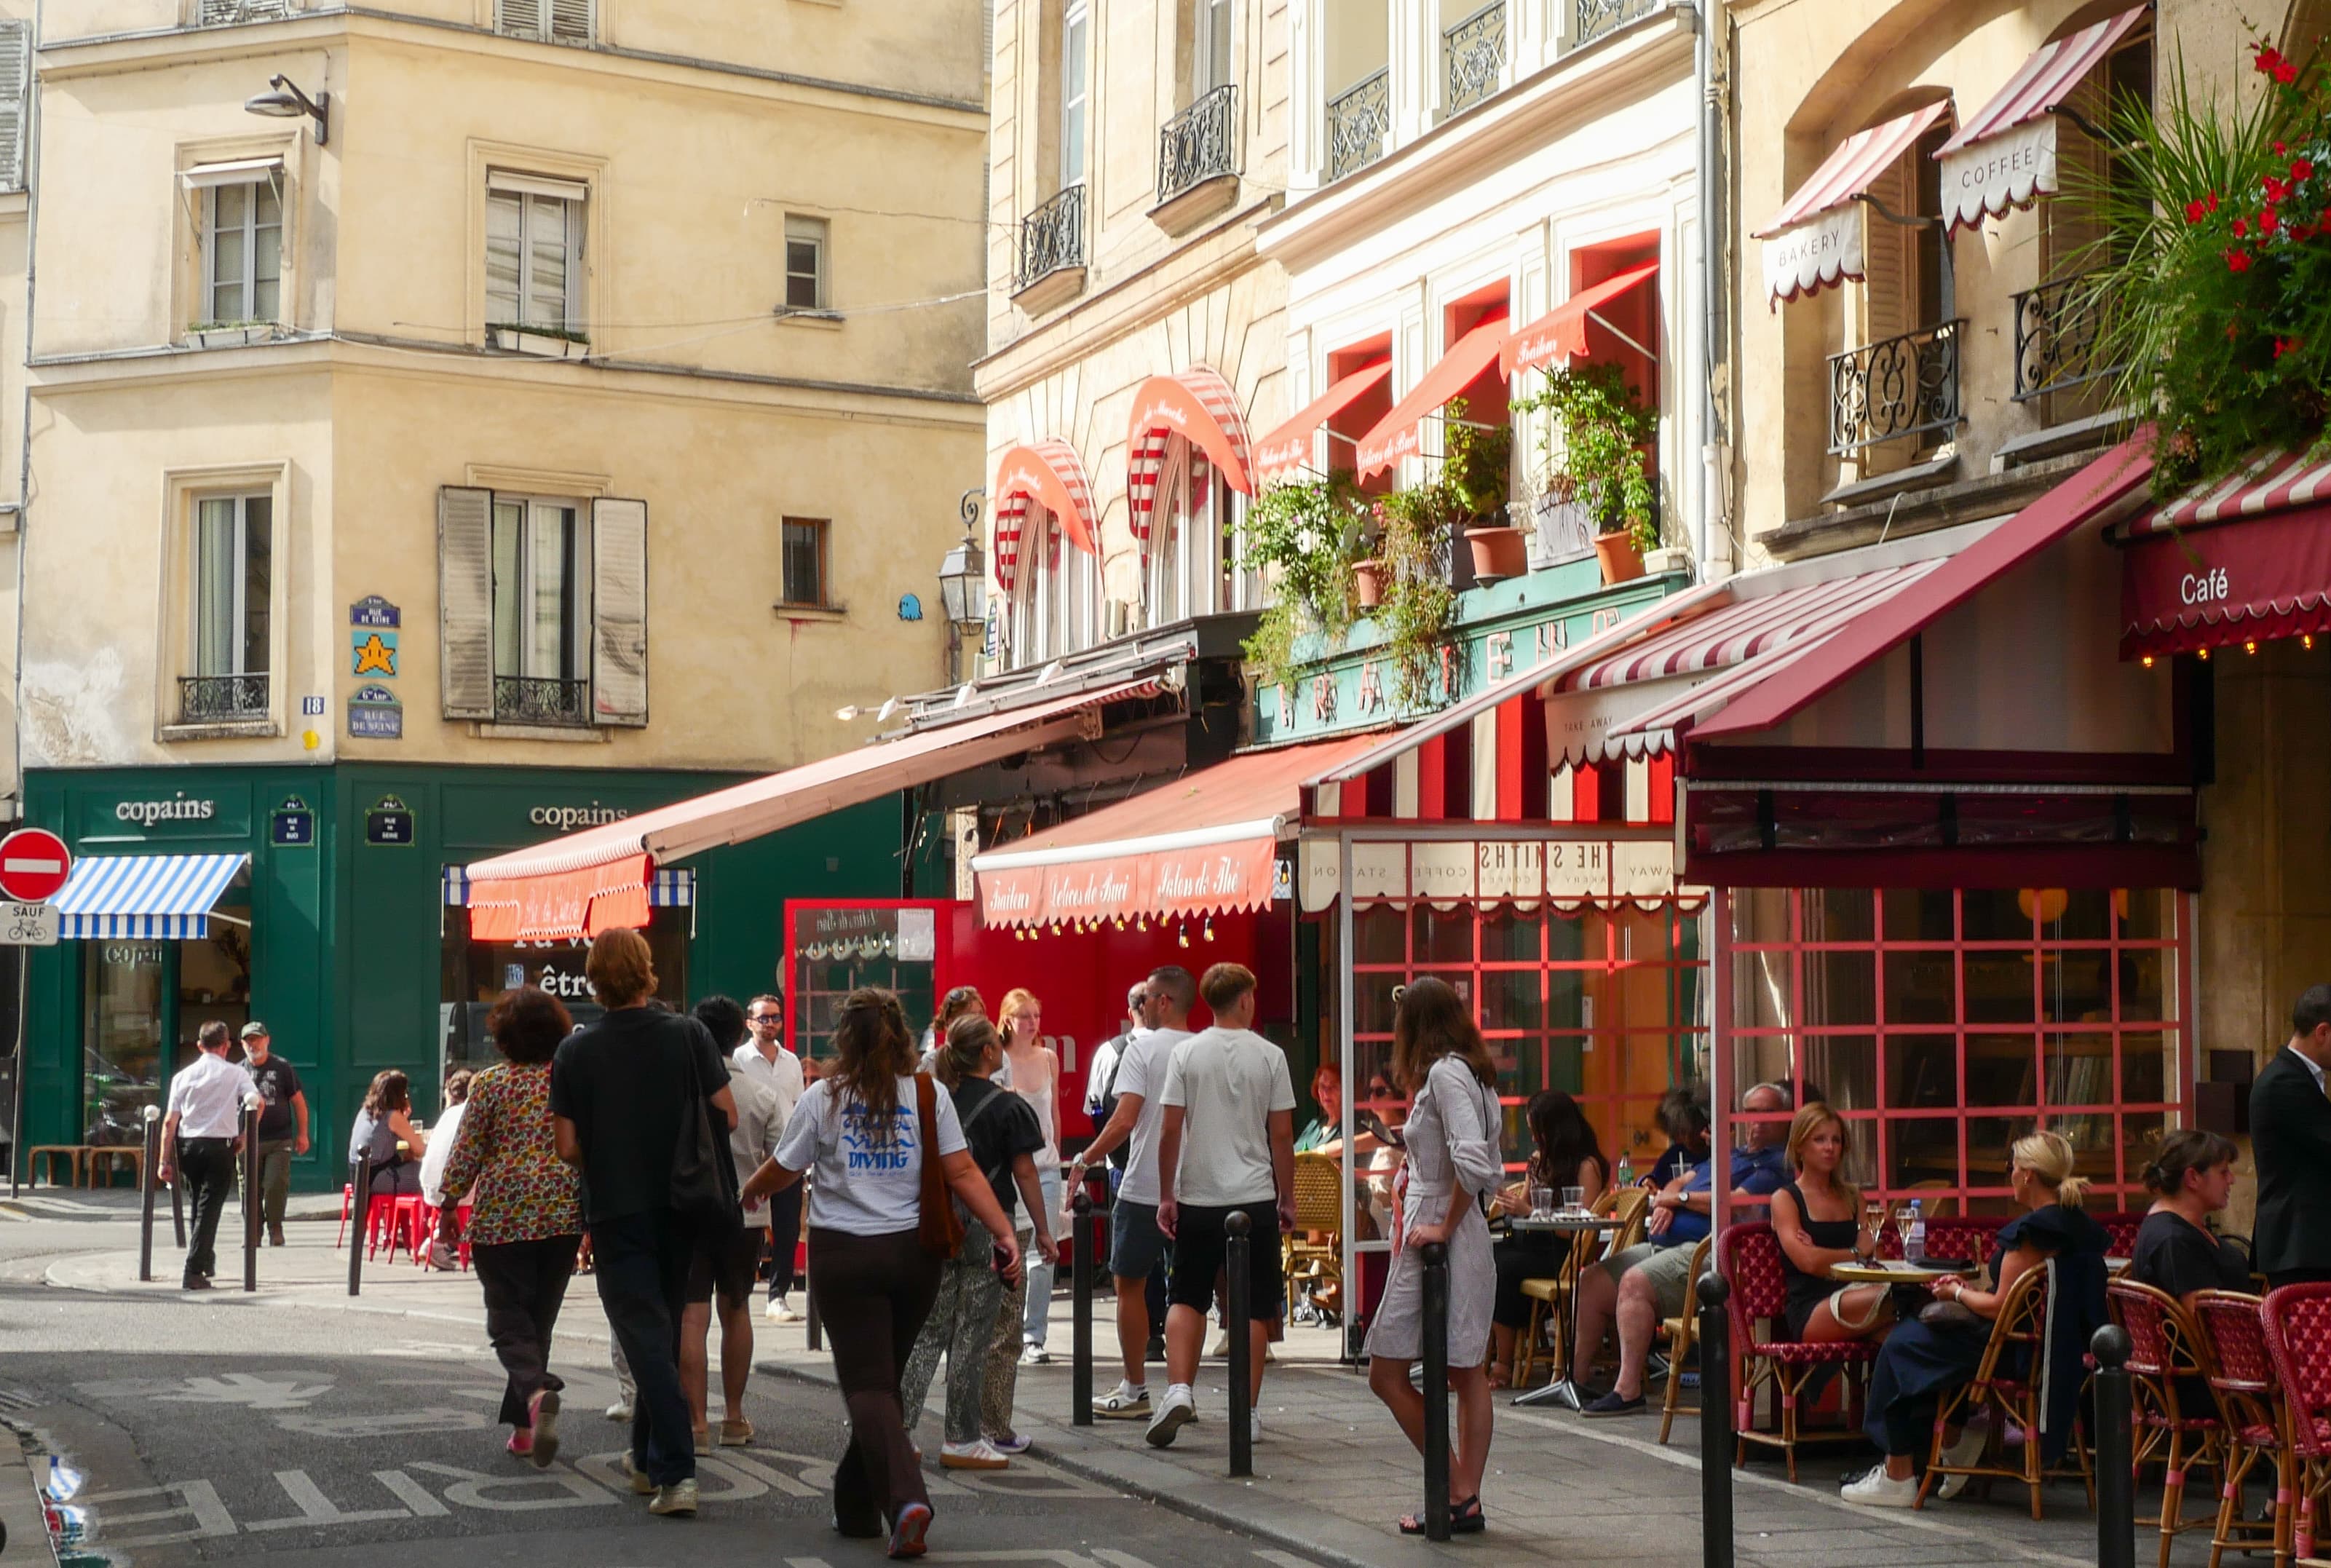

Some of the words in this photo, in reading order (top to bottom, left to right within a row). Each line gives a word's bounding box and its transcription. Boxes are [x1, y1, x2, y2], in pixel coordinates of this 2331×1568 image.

[1962, 147, 2033, 188] COFFEE
[1779, 229, 1839, 267] BAKERY
[1384, 437, 1393, 460] de
[2181, 567, 2228, 605] Café
[1276, 609, 1620, 728] TRATEUR
[306, 697, 321, 714] 18
[1564, 720, 1583, 733] TAKE
[1591, 716, 1613, 729] AWAY
[116, 791, 214, 826] copains
[530, 800, 628, 831] copains
[1084, 874, 1098, 906] de
[1100, 868, 1129, 902] Buci
[1157, 862, 1192, 898] Salon
[1195, 861, 1209, 896] de
[12, 906, 45, 917] SAUF
[848, 1151, 909, 1169] DIVING
